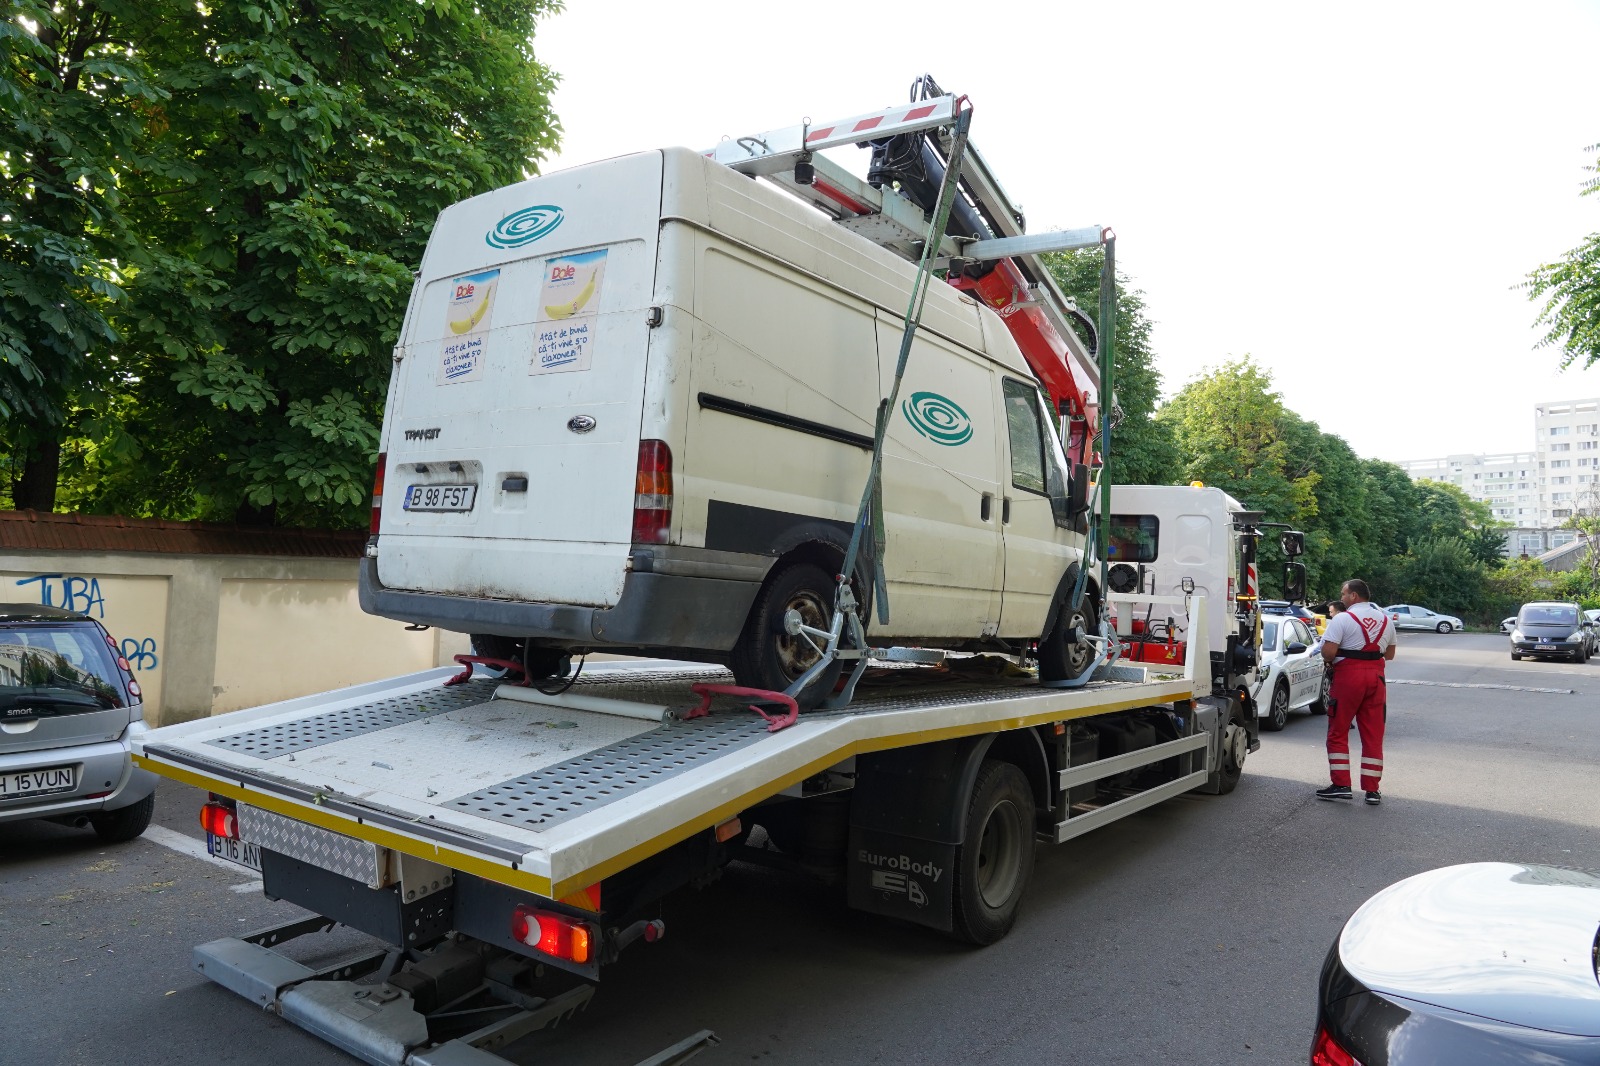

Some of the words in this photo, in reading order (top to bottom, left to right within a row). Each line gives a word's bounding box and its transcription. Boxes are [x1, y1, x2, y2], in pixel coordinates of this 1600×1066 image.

[551, 265, 576, 280] Dole
[456, 284, 475, 297] Dole
[539, 330, 557, 342] Atât
[560, 328, 567, 338] de
[569, 324, 588, 335] bună
[459, 343, 466, 352] de
[467, 337, 482, 348] bună
[558, 339, 574, 348] vine
[459, 351, 470, 360] vine
[405, 428, 441, 441] TRANSIT
[412, 488, 422, 506] B
[424, 488, 439, 506] 98
[441, 487, 468, 507] FST
[16, 573, 105, 618] TUBA
[7, 707, 33, 716] smart
[14, 774, 31, 791] 15
[33, 769, 71, 788] VUN
[214, 835, 222, 853] B
[224, 839, 239, 860] 116
[858, 849, 943, 882] EuroBody
